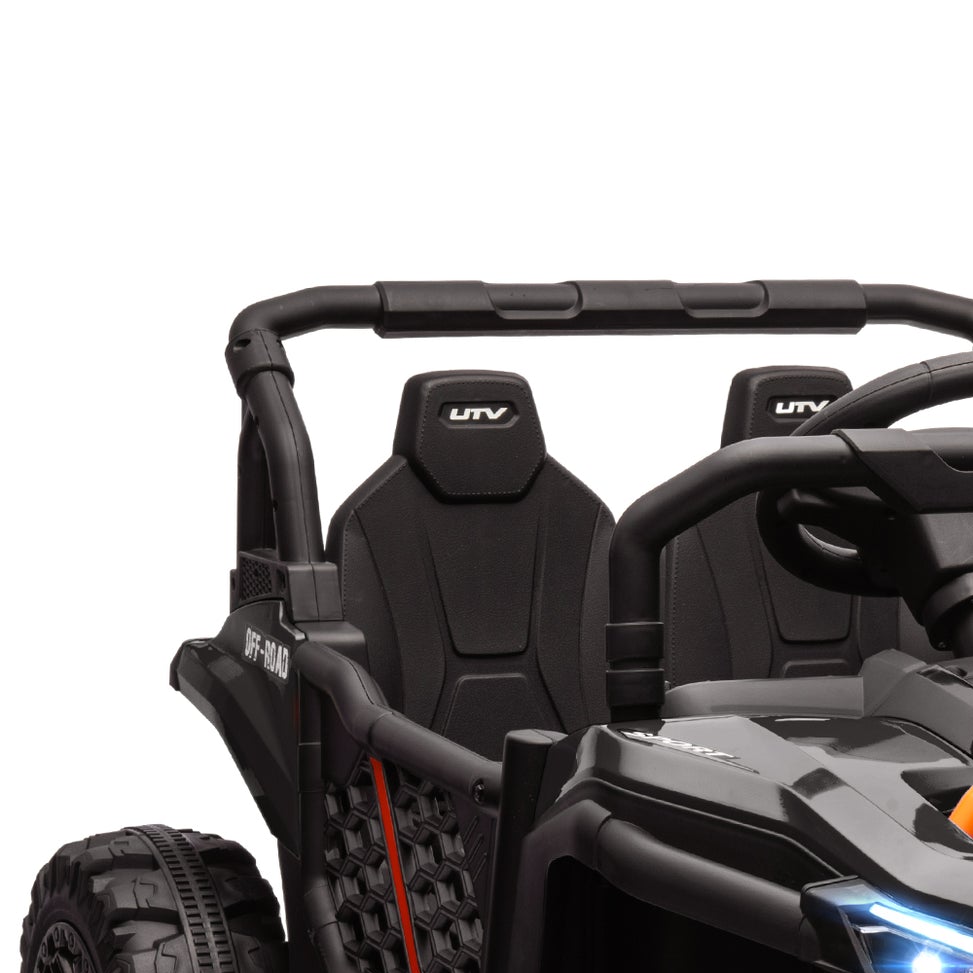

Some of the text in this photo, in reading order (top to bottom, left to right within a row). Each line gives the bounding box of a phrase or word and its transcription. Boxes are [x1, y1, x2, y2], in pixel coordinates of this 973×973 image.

[449, 407, 508, 420] UTV
[775, 400, 831, 414] UTV
[245, 627, 289, 680] OFF-ROAD
